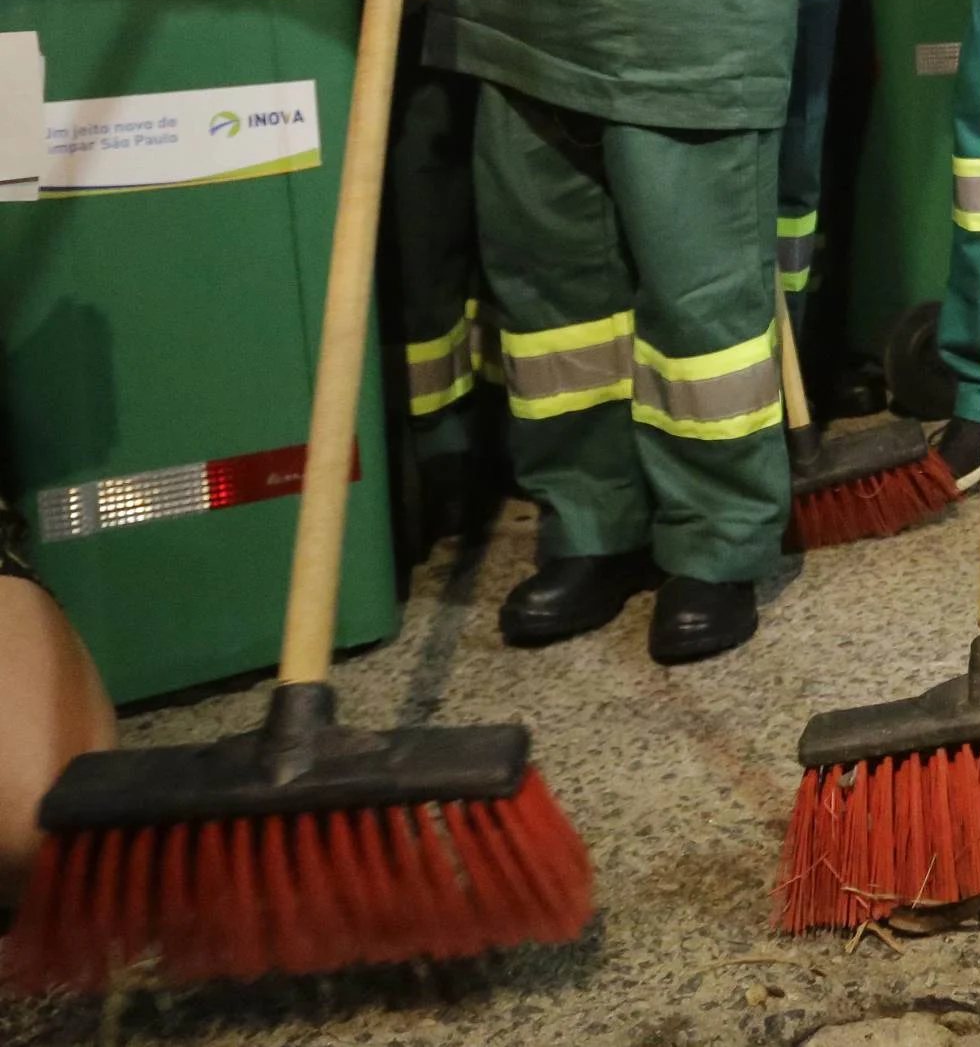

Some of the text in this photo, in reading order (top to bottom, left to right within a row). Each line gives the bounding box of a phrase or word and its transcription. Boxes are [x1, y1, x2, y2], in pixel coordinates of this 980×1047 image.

[73, 122, 110, 140] jeito
[114, 119, 153, 133] novo
[157, 115, 178, 129] de
[247, 108, 305, 128] INOVA
[101, 136, 130, 150] São
[134, 132, 179, 147] Paulo
